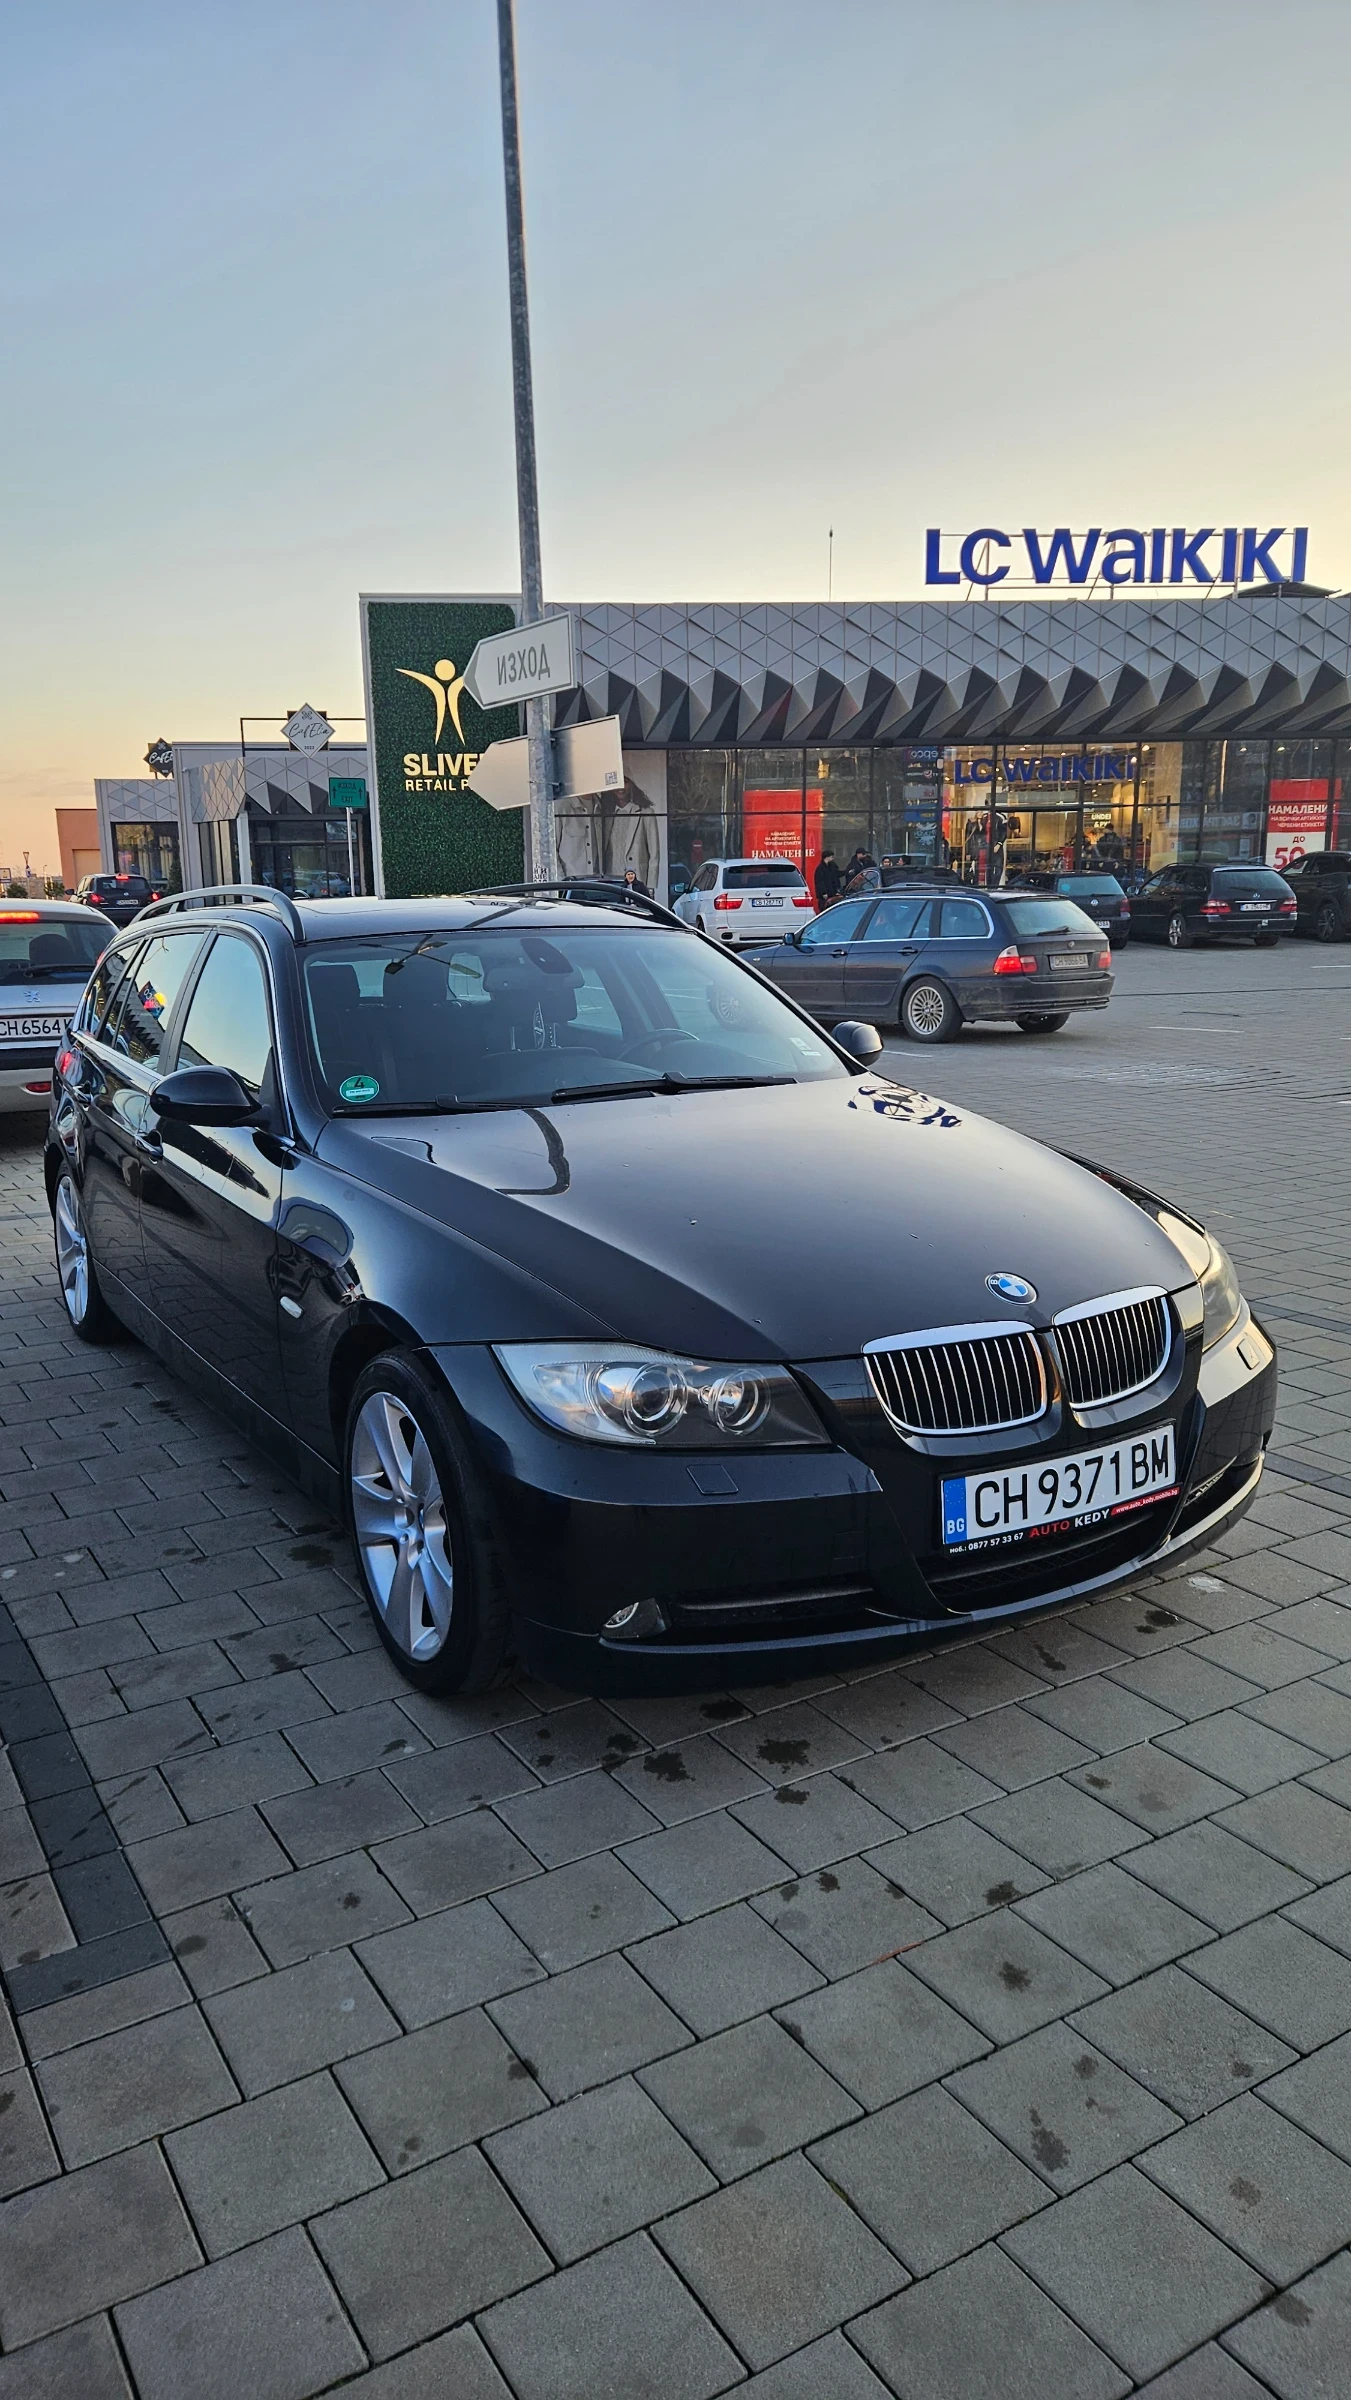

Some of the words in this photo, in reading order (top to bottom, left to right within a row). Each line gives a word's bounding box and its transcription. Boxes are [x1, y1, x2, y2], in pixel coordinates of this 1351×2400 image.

[926, 528, 1012, 585] LC
[496, 643, 551, 686] ИЗХОД
[403, 753, 486, 776] SLIVE
[953, 758, 993, 784] LC
[405, 779, 457, 791] RETAIL
[341, 795, 353, 803] EXIT
[1292, 835, 1306, 844] ДО
[22, 1019, 61, 1035] 6564
[353, 1076, 365, 1088] 4
[974, 1473, 1028, 1528] CH
[1037, 1450, 1121, 1516] 9371
[1131, 1434, 1169, 1490] BM
[946, 1518, 965, 1535] BG
[1030, 1520, 1070, 1538] AUTO
[1074, 1508, 1111, 1528] KEDY
[967, 1540, 988, 1551] 0877
[990, 1537, 1001, 1546] 57
[1001, 1535, 1012, 1543] 33
[1013, 1532, 1024, 1541] 67
